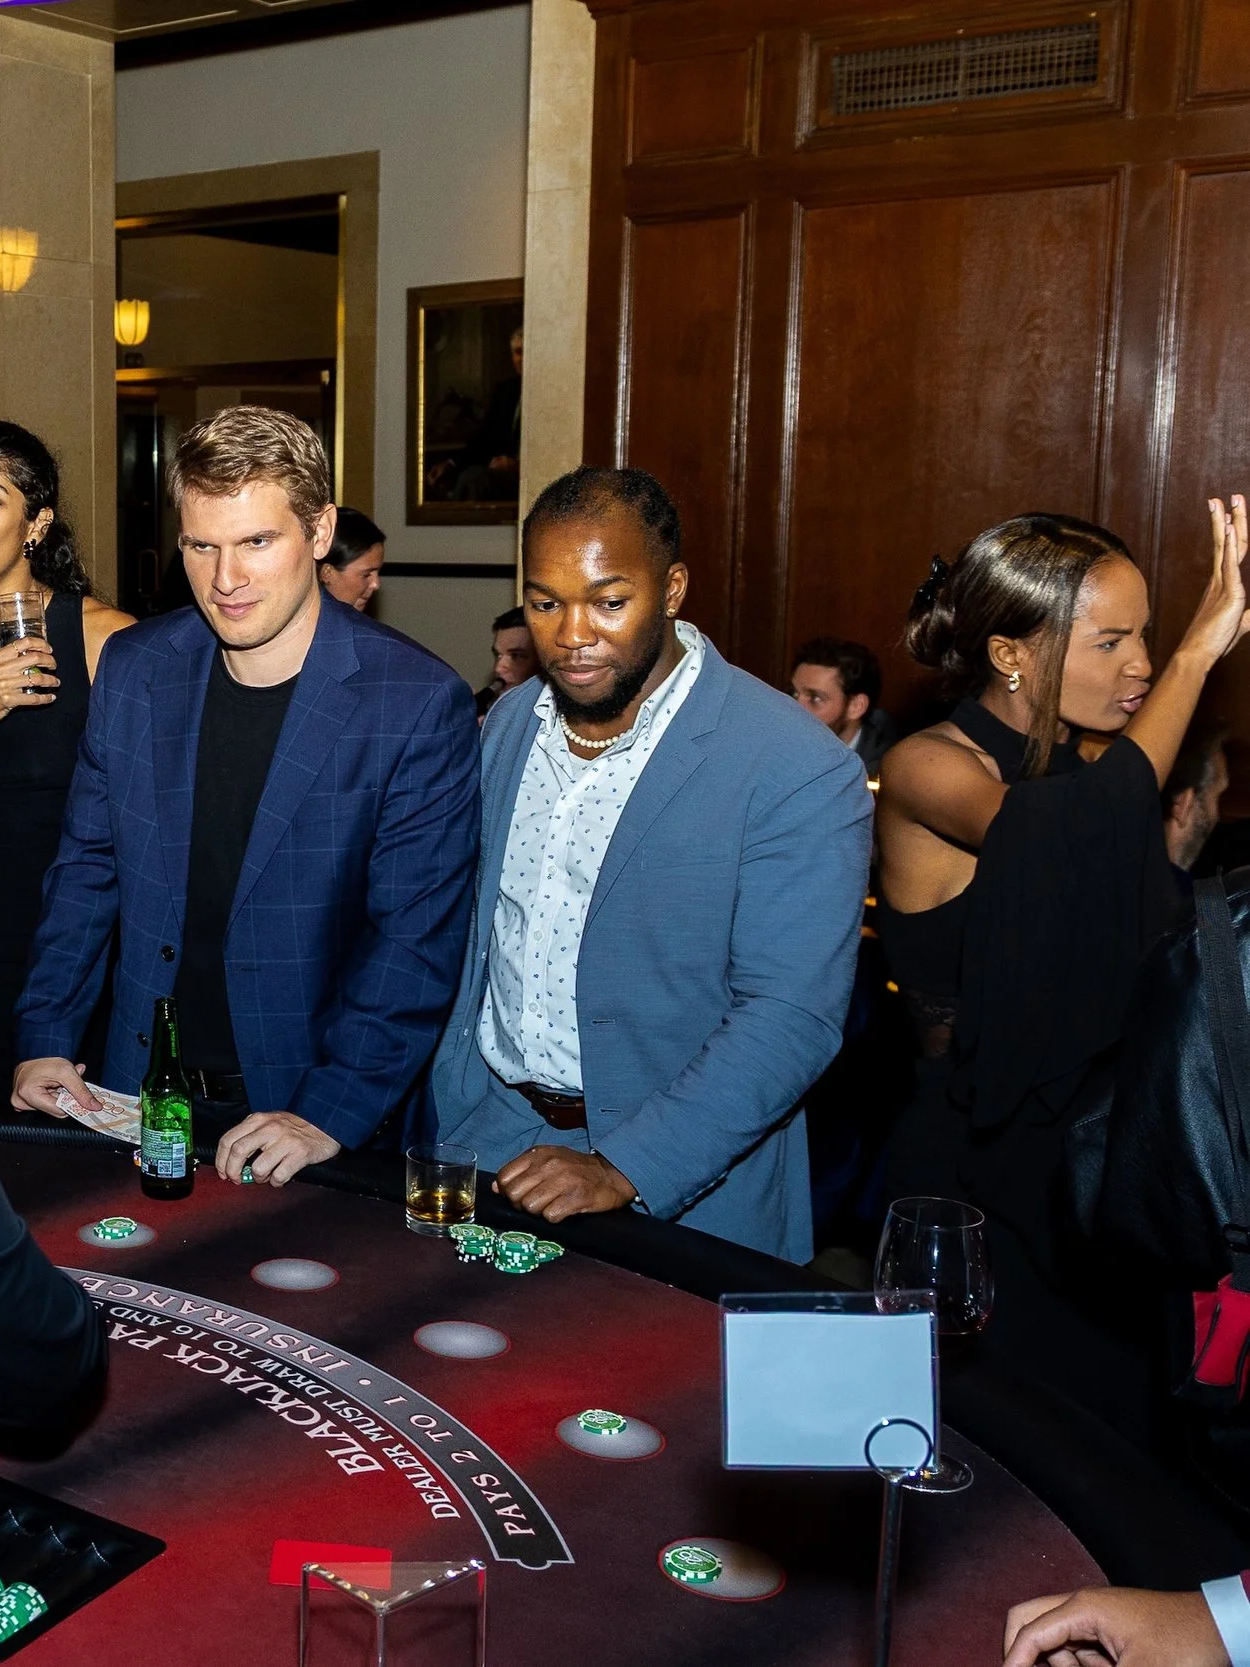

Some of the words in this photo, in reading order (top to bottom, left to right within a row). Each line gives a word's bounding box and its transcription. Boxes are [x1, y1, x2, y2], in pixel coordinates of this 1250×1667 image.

[79, 1276, 351, 1373] INSURANCE
[109, 1306, 172, 1327] AND
[171, 1324, 210, 1341] 16
[213, 1340, 253, 1360] TO
[251, 1358, 333, 1398] DRAW
[163, 1343, 385, 1476] BLACKJACK
[384, 1395, 407, 1406] 1
[322, 1400, 395, 1443] MUST
[409, 1414, 453, 1443] TO
[451, 1450, 482, 1463] 2
[382, 1443, 461, 1519] DEALER
[471, 1473, 535, 1536] PAYS
